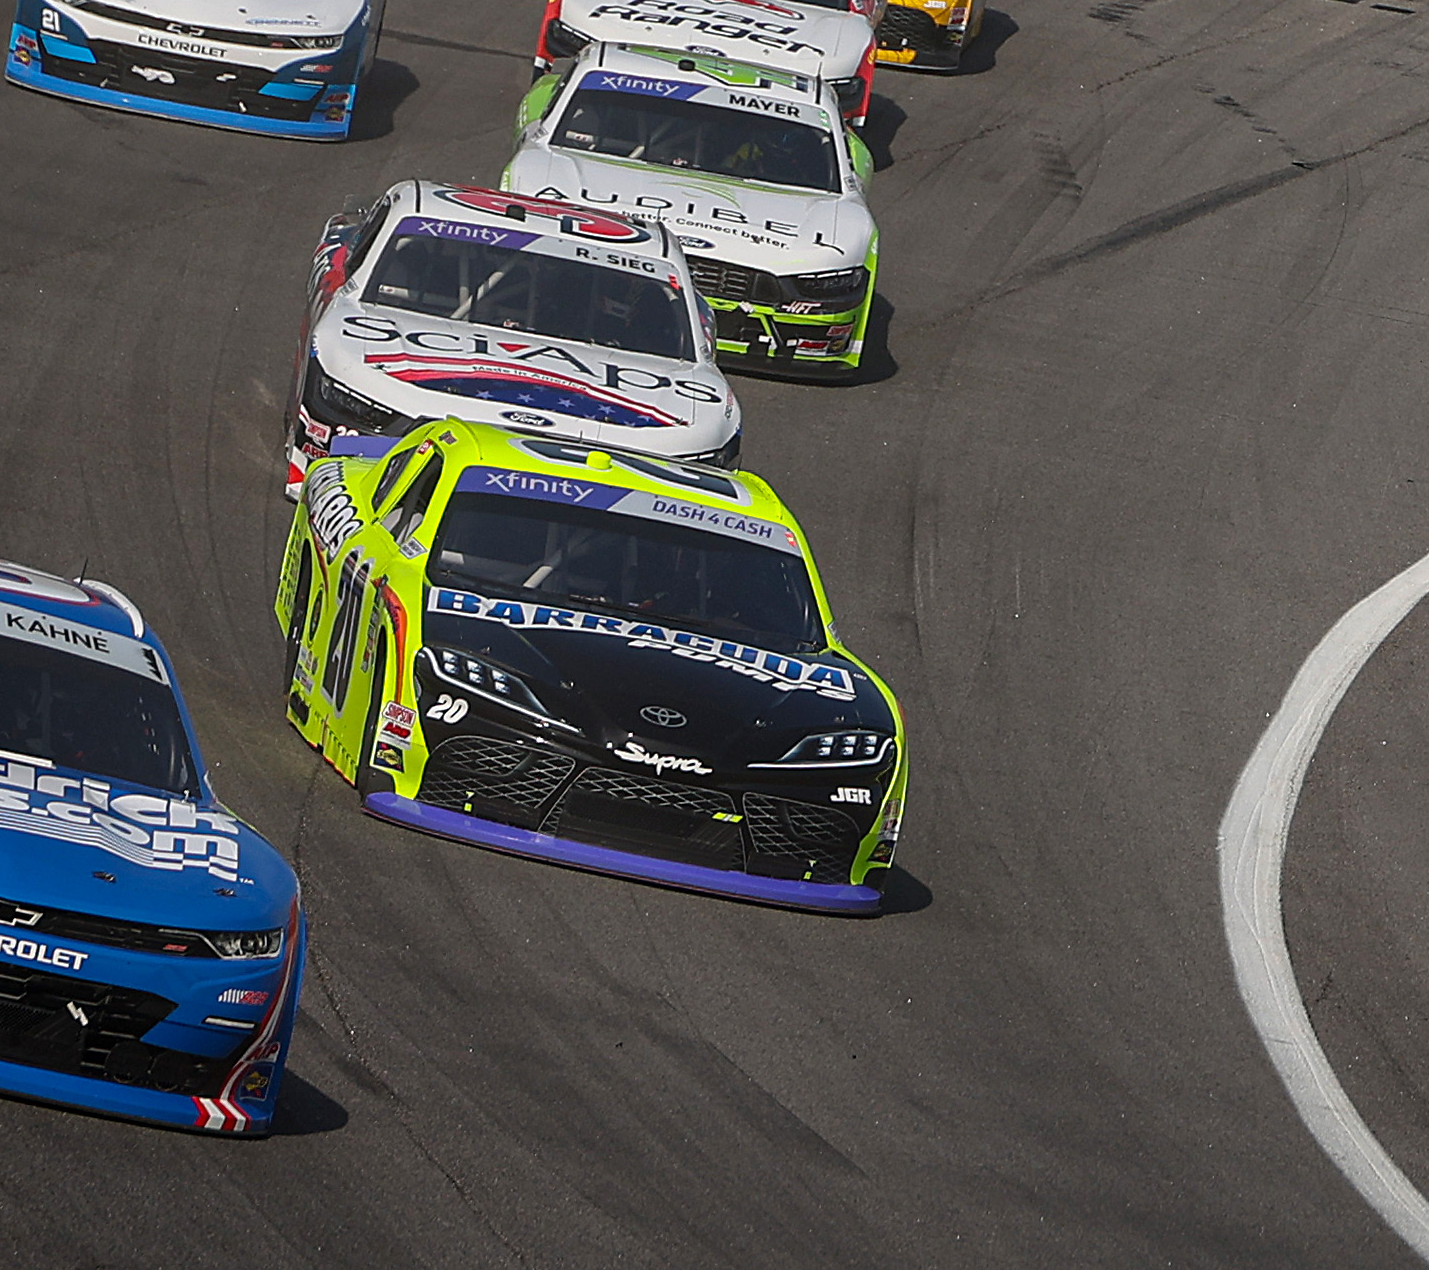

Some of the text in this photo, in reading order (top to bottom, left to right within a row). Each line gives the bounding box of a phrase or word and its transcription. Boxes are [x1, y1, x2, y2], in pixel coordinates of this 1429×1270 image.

[41, 8, 61, 32] 21
[588, 4, 827, 58] Ranger
[137, 33, 228, 59] CHEVROLET
[600, 74, 680, 98] xfinity
[728, 93, 801, 120] MAYER
[417, 219, 509, 247] xfinity
[534, 186, 846, 256] AUDIBEL
[675, 217, 738, 237] Connect
[740, 229, 791, 251] better.
[606, 253, 656, 274] SIEG
[530, 371, 588, 391] America
[508, 411, 546, 427] Ford
[485, 470, 594, 502] xfinity
[652, 498, 773, 541] DASH 4 CASH
[6, 611, 111, 654] KAHNE
[431, 588, 849, 691] BARRACUDA
[426, 693, 469, 725] 20
[614, 741, 713, 776] Supra
[830, 787, 872, 805] JGR
